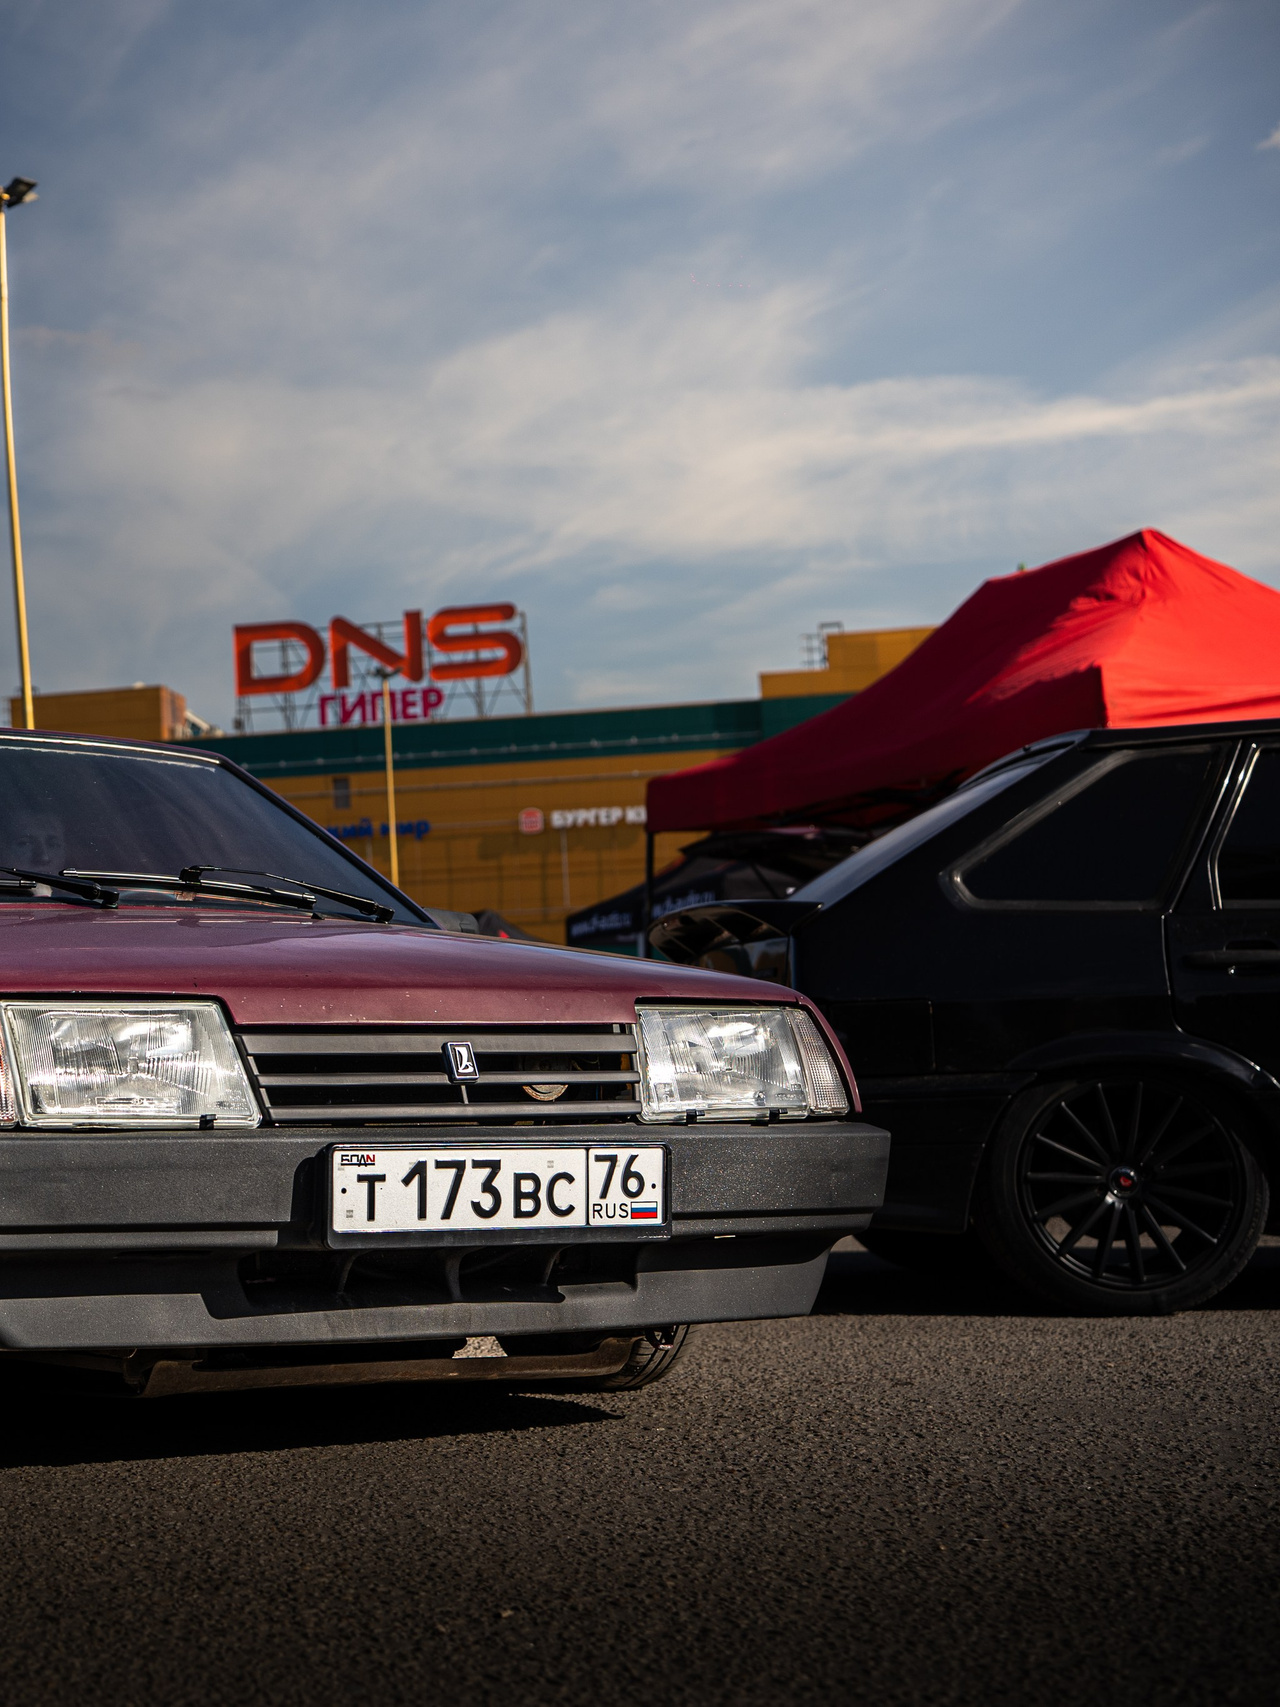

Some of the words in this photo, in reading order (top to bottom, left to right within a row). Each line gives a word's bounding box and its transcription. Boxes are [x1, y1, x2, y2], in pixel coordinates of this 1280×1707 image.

[233, 602, 525, 697] DNS
[320, 687, 443, 725] ГИПЕР
[550, 806, 624, 829] БУРГЕР
[594, 1153, 645, 1200] 76
[592, 1203, 629, 1219] RUS
